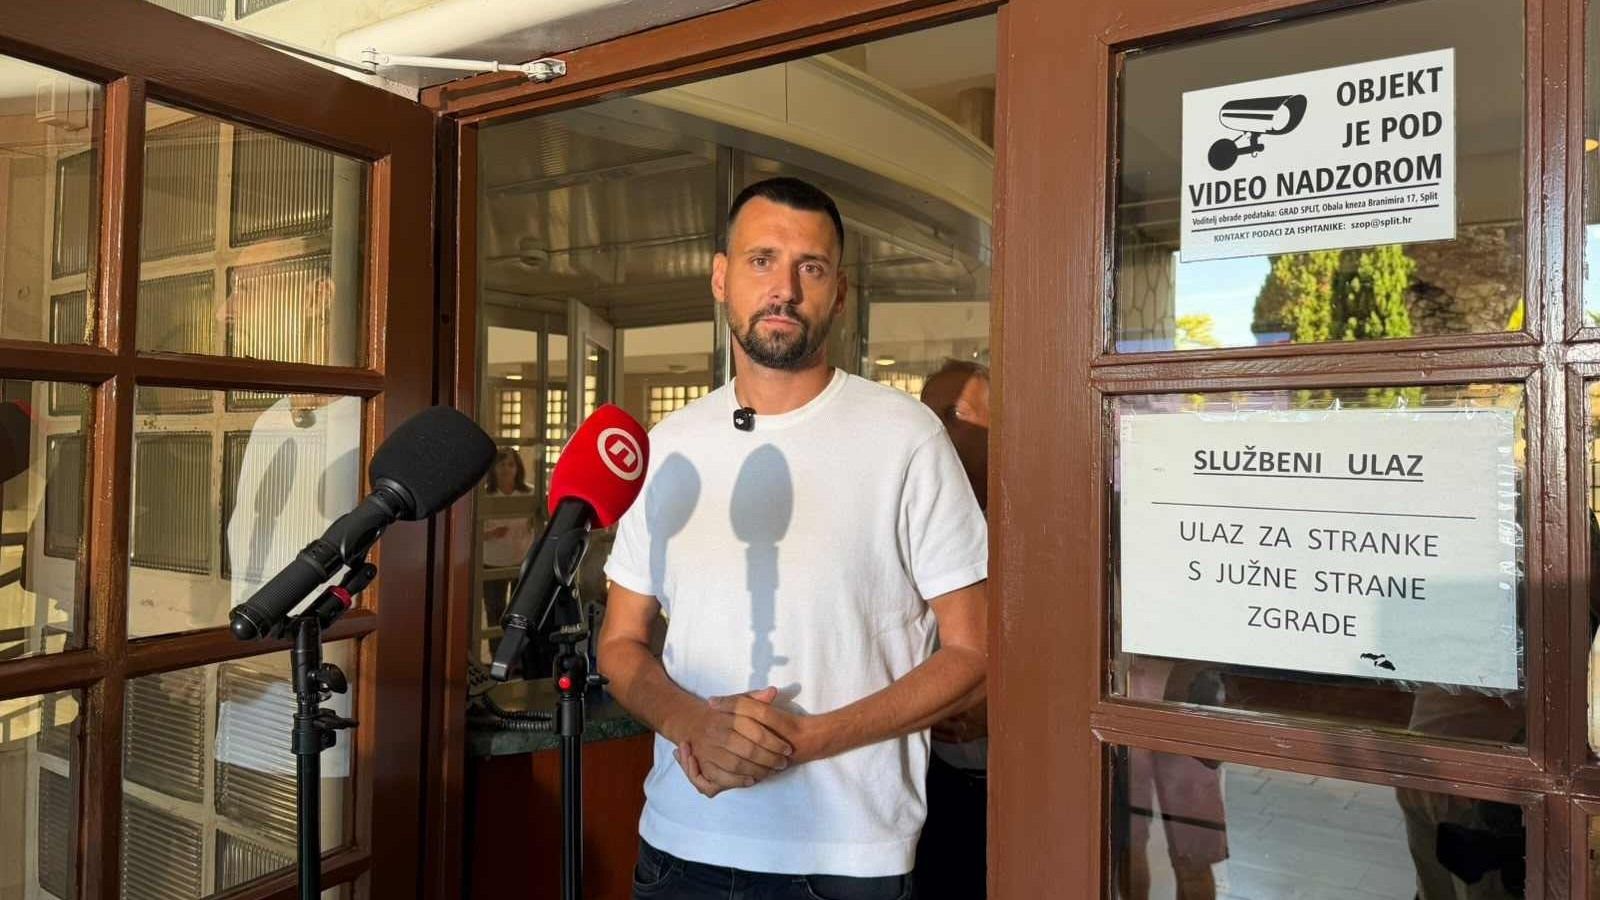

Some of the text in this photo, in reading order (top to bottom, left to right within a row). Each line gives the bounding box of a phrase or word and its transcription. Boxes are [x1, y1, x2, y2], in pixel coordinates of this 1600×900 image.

[1336, 66, 1443, 106] OBJEKT
[1342, 110, 1443, 148] JE POD
[1189, 153, 1442, 207] VIDEO NADZOROM
[1192, 215, 1217, 225] Voditelj
[1218, 212, 1242, 223] obrade
[1243, 208, 1278, 221] podataka:
[1278, 206, 1299, 216] GRAD
[1322, 202, 1344, 212] Obala
[1345, 199, 1366, 209] kneza
[1368, 196, 1405, 207] Branimira
[1420, 191, 1439, 202] Split
[1214, 216, 1413, 242] KONTAKT PODACI ZA ISPITANIKE: szop@split.hr
[1193, 446, 1424, 476] SLUŽBENI ULAZ
[1179, 521, 1440, 557] ULAZ ZA STRANKE
[1188, 560, 1426, 600] S JUŽNE STRANE
[1247, 606, 1358, 637] ZGRADE
